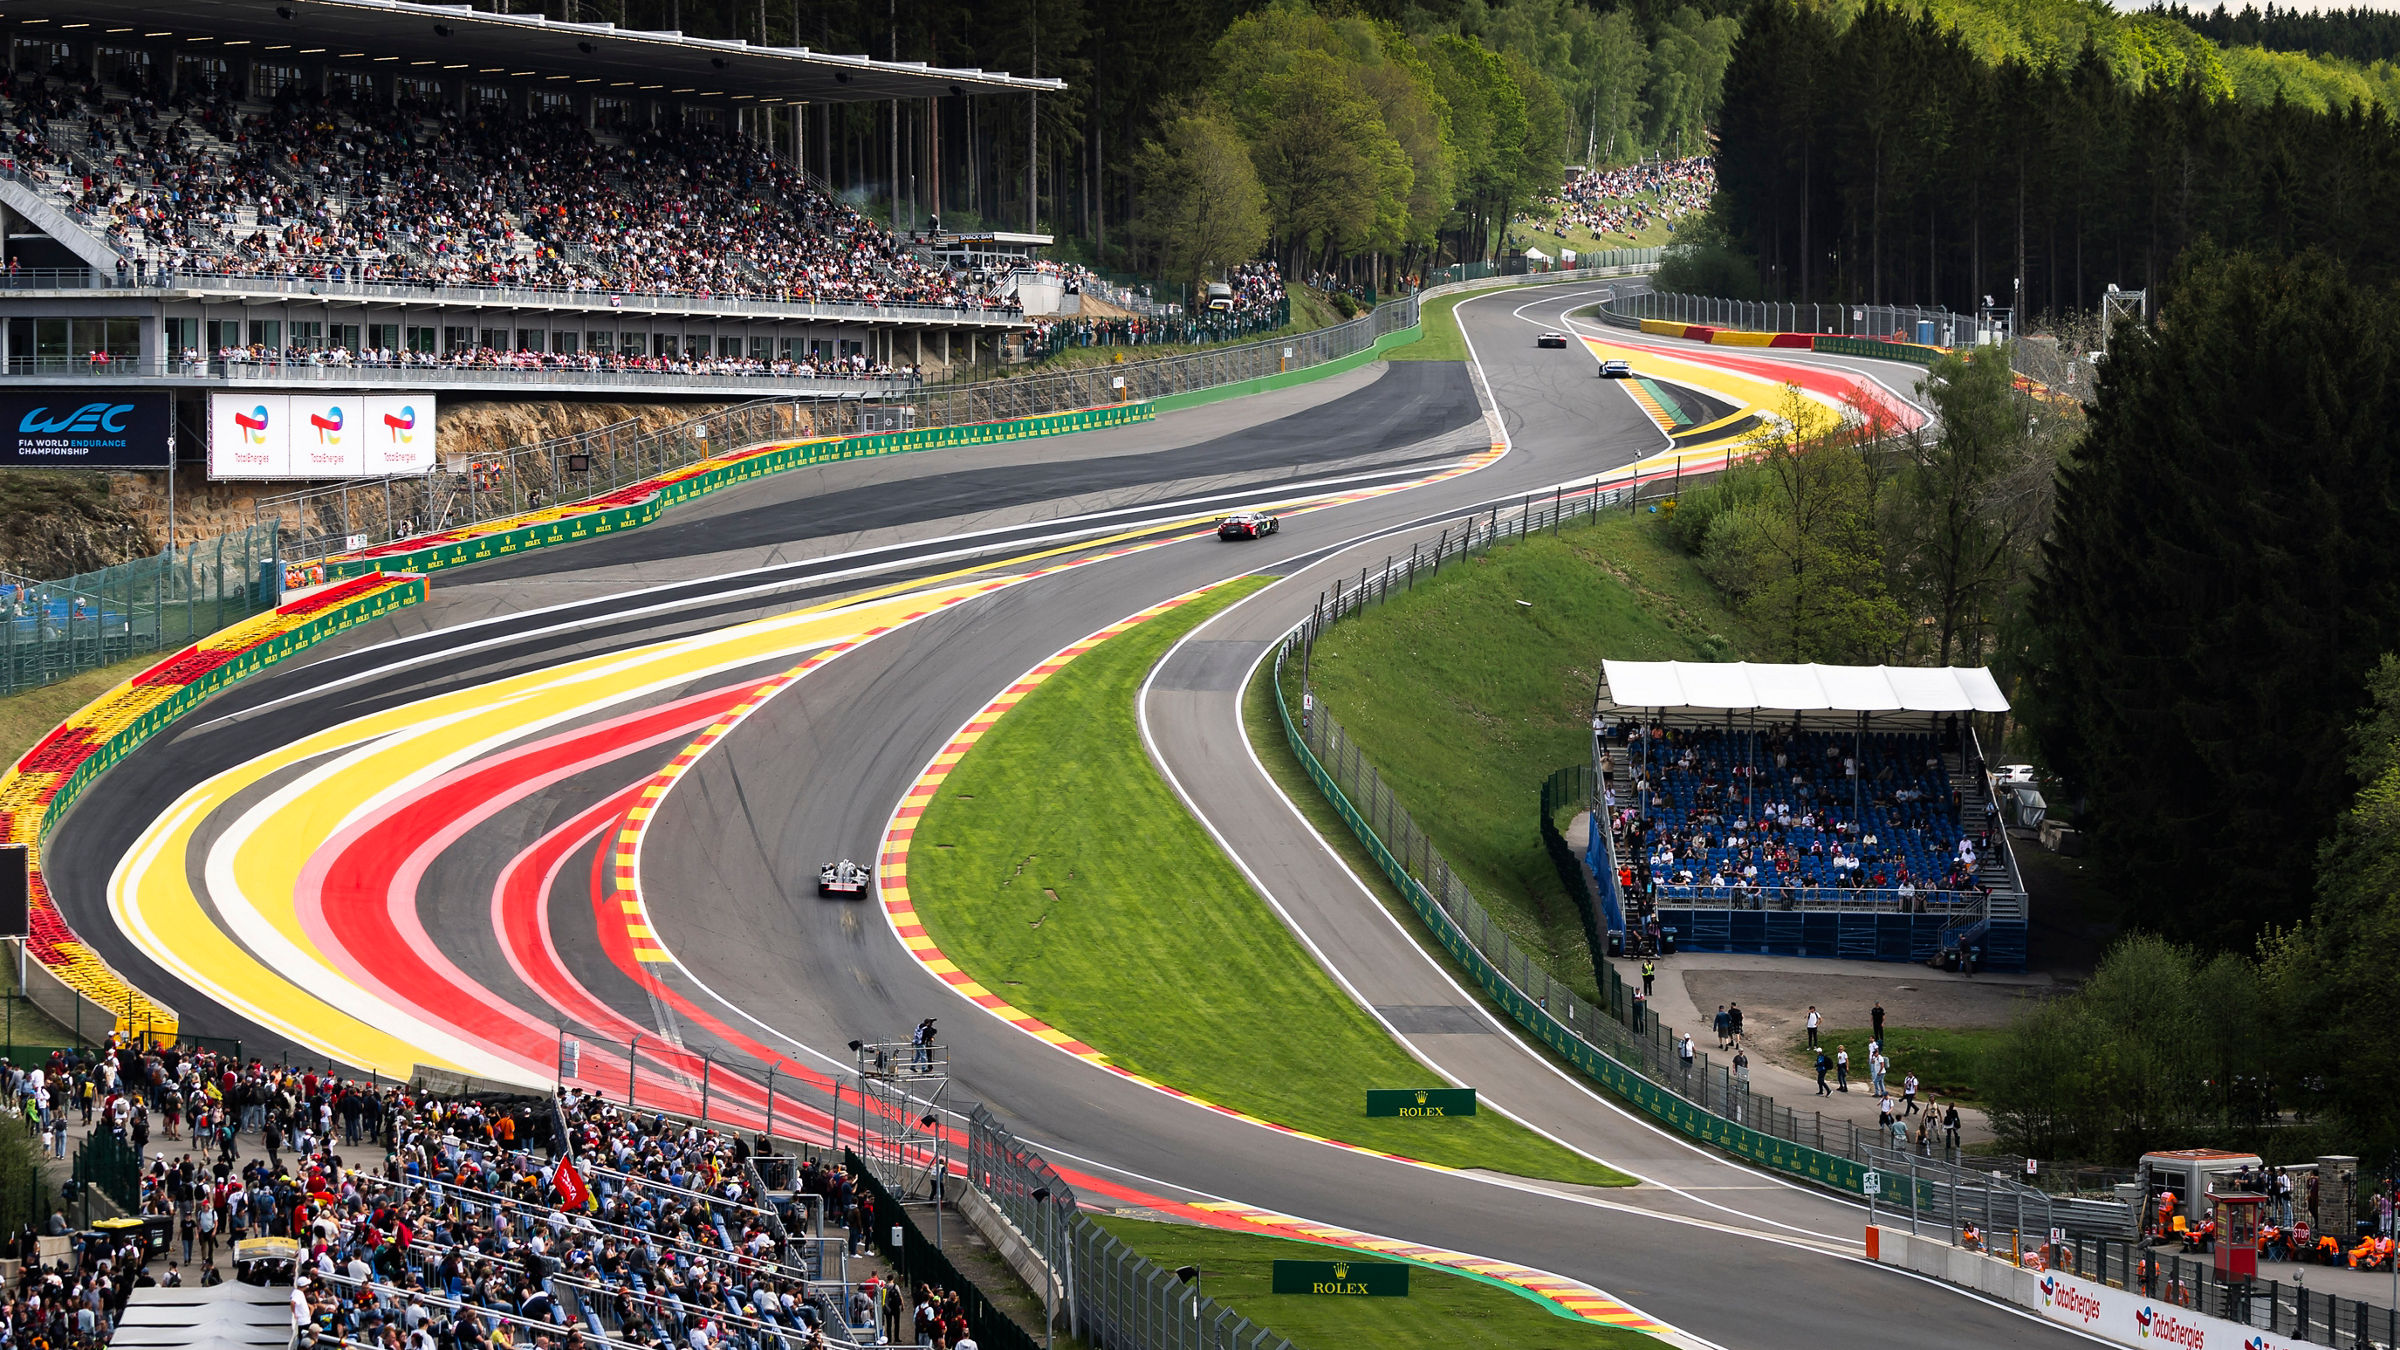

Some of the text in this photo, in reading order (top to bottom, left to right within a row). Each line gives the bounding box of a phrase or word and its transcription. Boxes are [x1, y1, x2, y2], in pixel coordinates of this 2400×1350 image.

[18, 403, 135, 434] WEC
[1399, 1107, 1444, 1117] ROLEX
[2294, 1228, 2310, 1238] STOP
[1313, 1282, 1369, 1294] ROLEX
[2054, 1282, 2100, 1324] TotalEnergies
[2152, 1312, 2204, 1350] TotalEnergies
